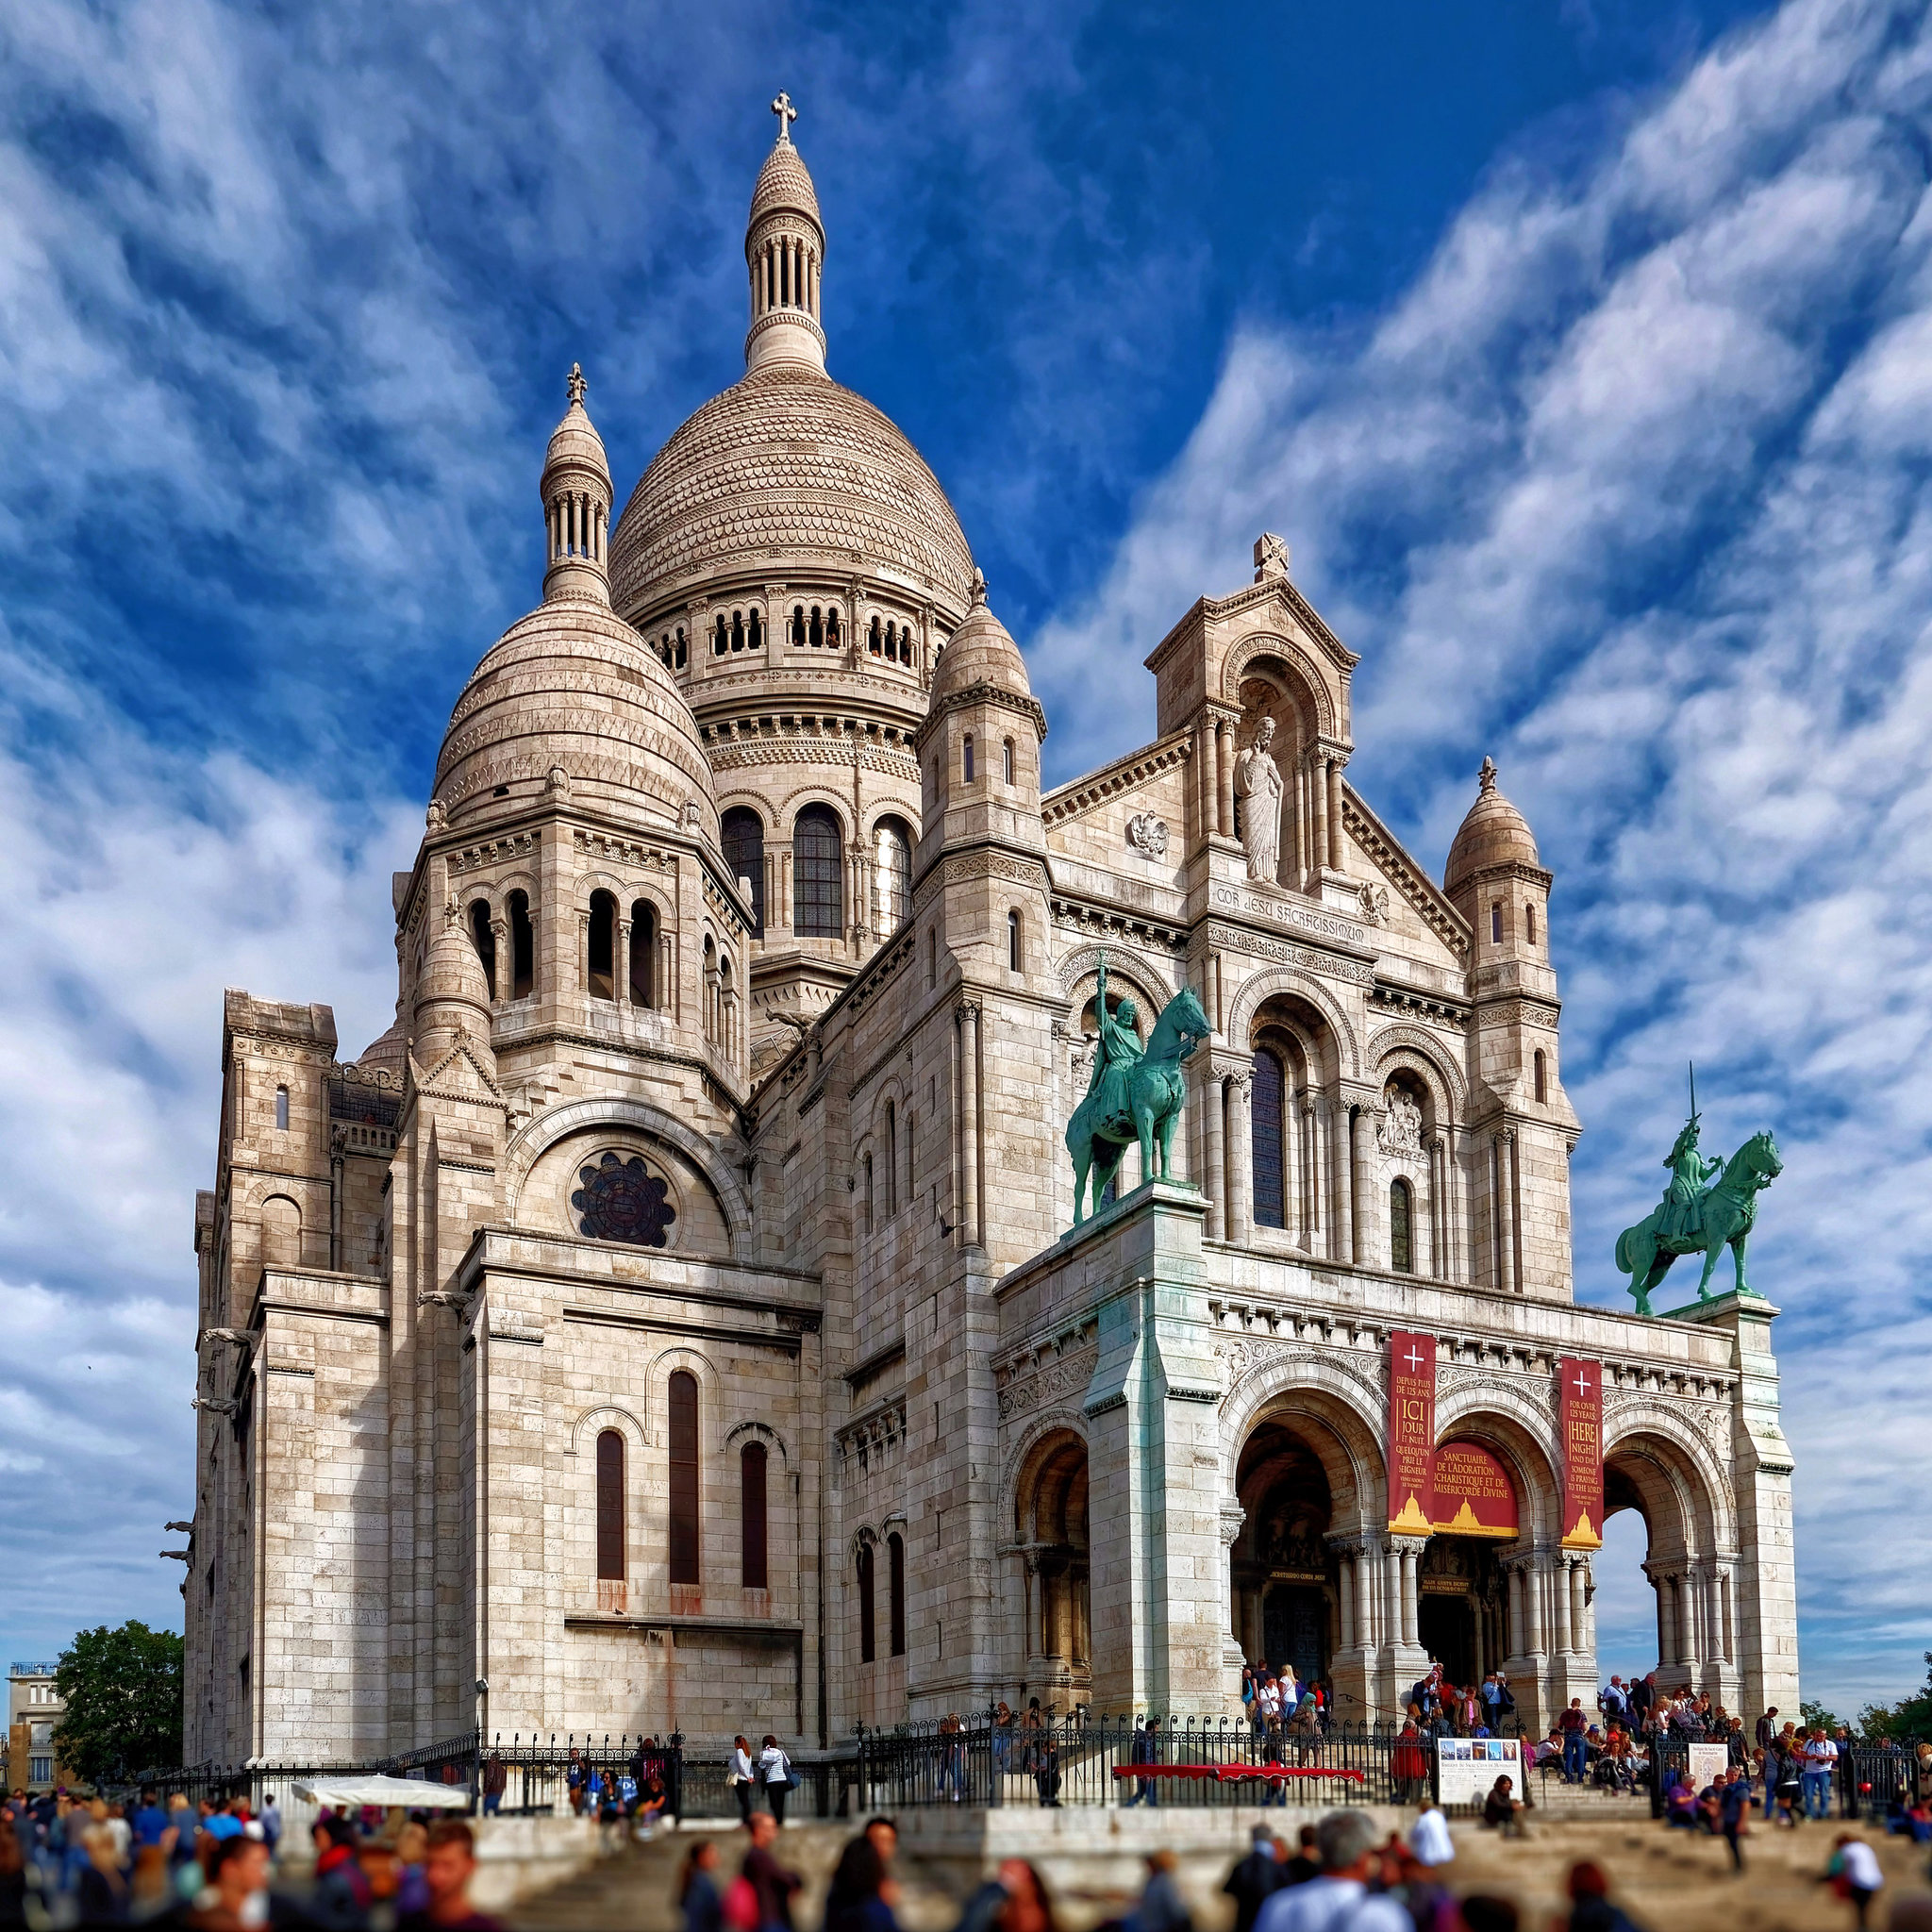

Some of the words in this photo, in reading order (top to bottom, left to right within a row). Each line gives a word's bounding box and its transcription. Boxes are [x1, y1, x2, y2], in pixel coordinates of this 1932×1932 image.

[1217, 888, 1240, 908] COR
[1276, 906, 1364, 943] SACRATISSIMUM
[1396, 1376, 1416, 1387] DEPUIS
[1396, 1386, 1406, 1394] DE
[1407, 1387, 1416, 1396] 125
[1570, 1400, 1580, 1409] FOR
[1403, 1399, 1424, 1422] ICI
[1570, 1409, 1578, 1418] 125
[1402, 1421, 1425, 1435] JOUR
[1571, 1421, 1595, 1442] HERE
[1572, 1442, 1595, 1456] NIGHT
[1402, 1456, 1415, 1465] PRIE
[1416, 1457, 1423, 1466] LE
[1437, 1461, 1446, 1472] DE
[1398, 1465, 1427, 1476] SEIGNEUR
[1571, 1465, 1596, 1476] SOMEONE
[1485, 1477, 1493, 1487] ET
[1495, 1478, 1505, 1488] DE
[1575, 1474, 1598, 1485] PRAYING
[1568, 1482, 1574, 1491] TO
[1575, 1484, 1587, 1492] THE
[1587, 1486, 1602, 1494] LORD
